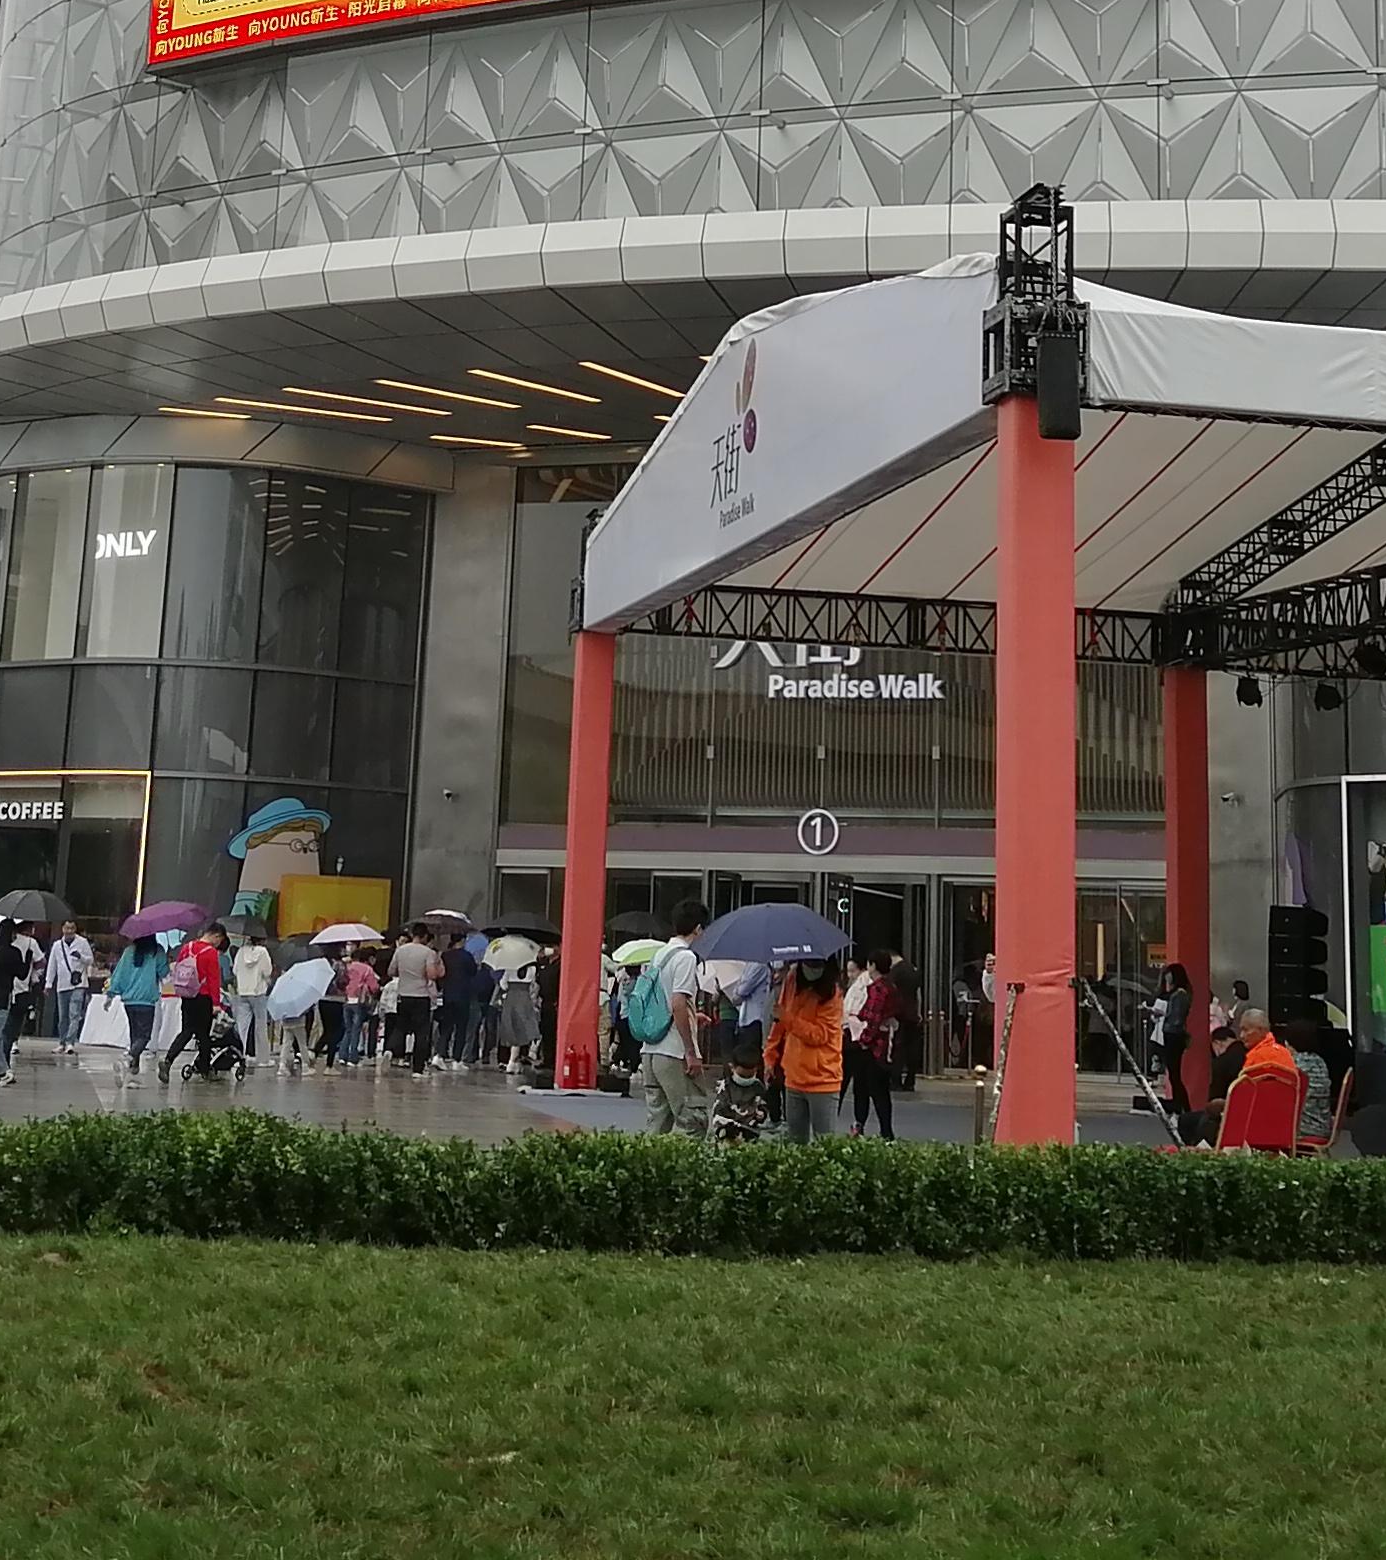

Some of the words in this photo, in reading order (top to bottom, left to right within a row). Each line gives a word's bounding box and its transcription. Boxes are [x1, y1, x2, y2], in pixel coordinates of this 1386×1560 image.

[155, 25, 239, 56] 向YOUNG新生
[710, 423, 742, 509] 天街
[719, 502, 741, 529] Paradise
[741, 492, 755, 517] Walk
[768, 673, 876, 699] Paradise
[877, 673, 946, 699] Walk
